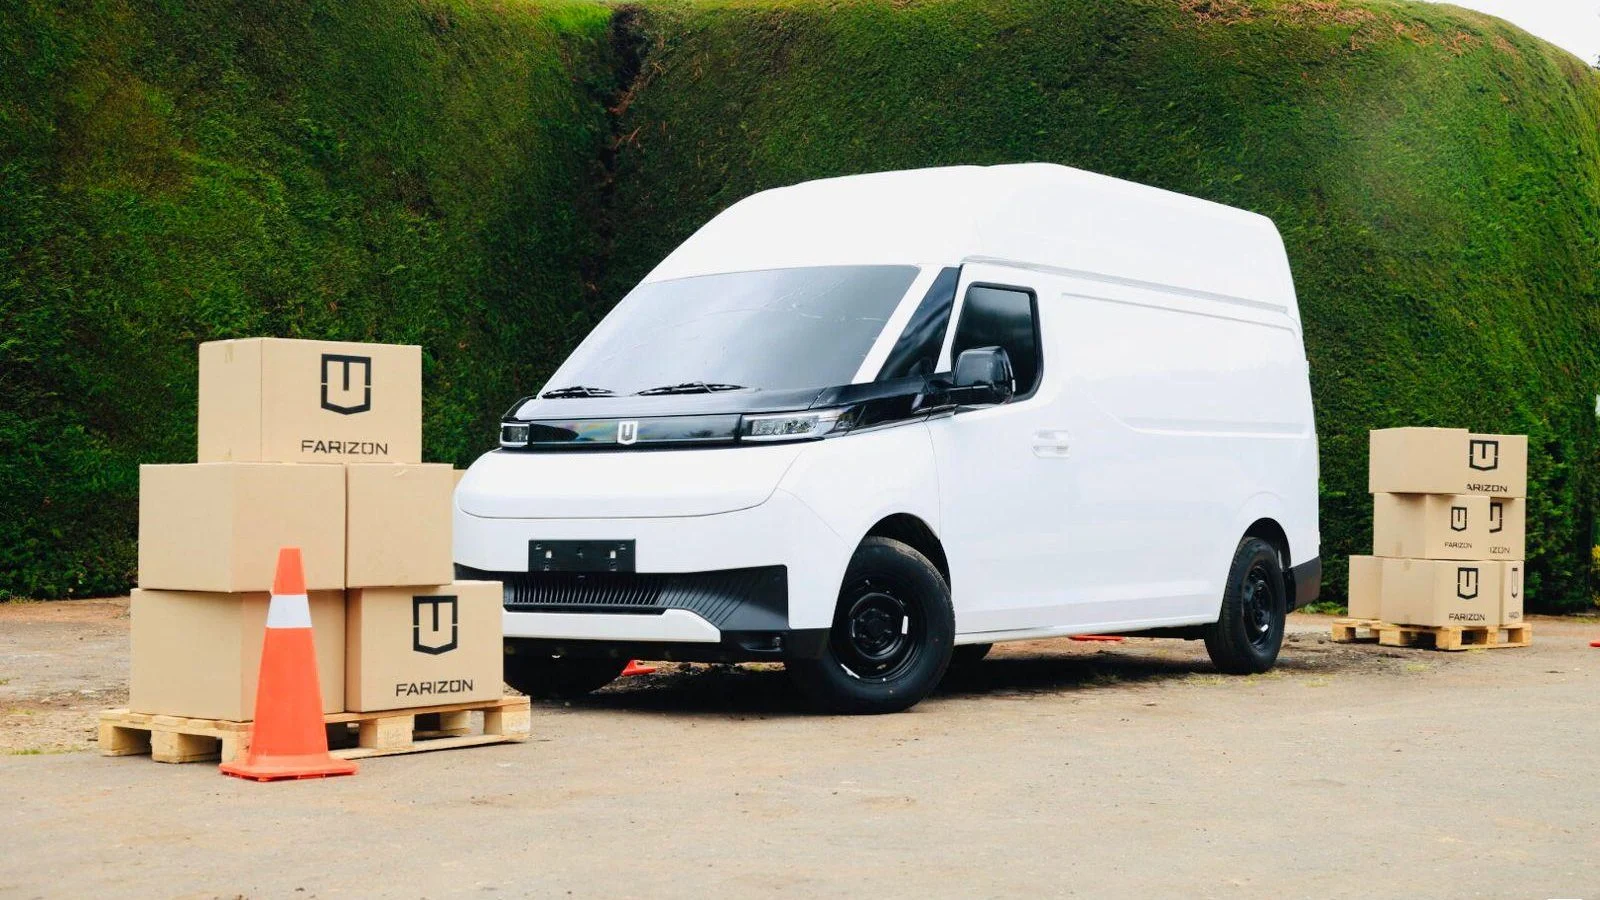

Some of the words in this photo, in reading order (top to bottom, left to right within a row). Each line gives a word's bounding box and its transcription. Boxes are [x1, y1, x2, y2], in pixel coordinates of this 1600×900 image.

[301, 440, 388, 456] FARIZON
[1467, 483, 1508, 493] ARIZON
[1444, 541, 1473, 550] FARIZON
[1448, 612, 1486, 622] FARIZON
[395, 678, 474, 697] FARIZON
